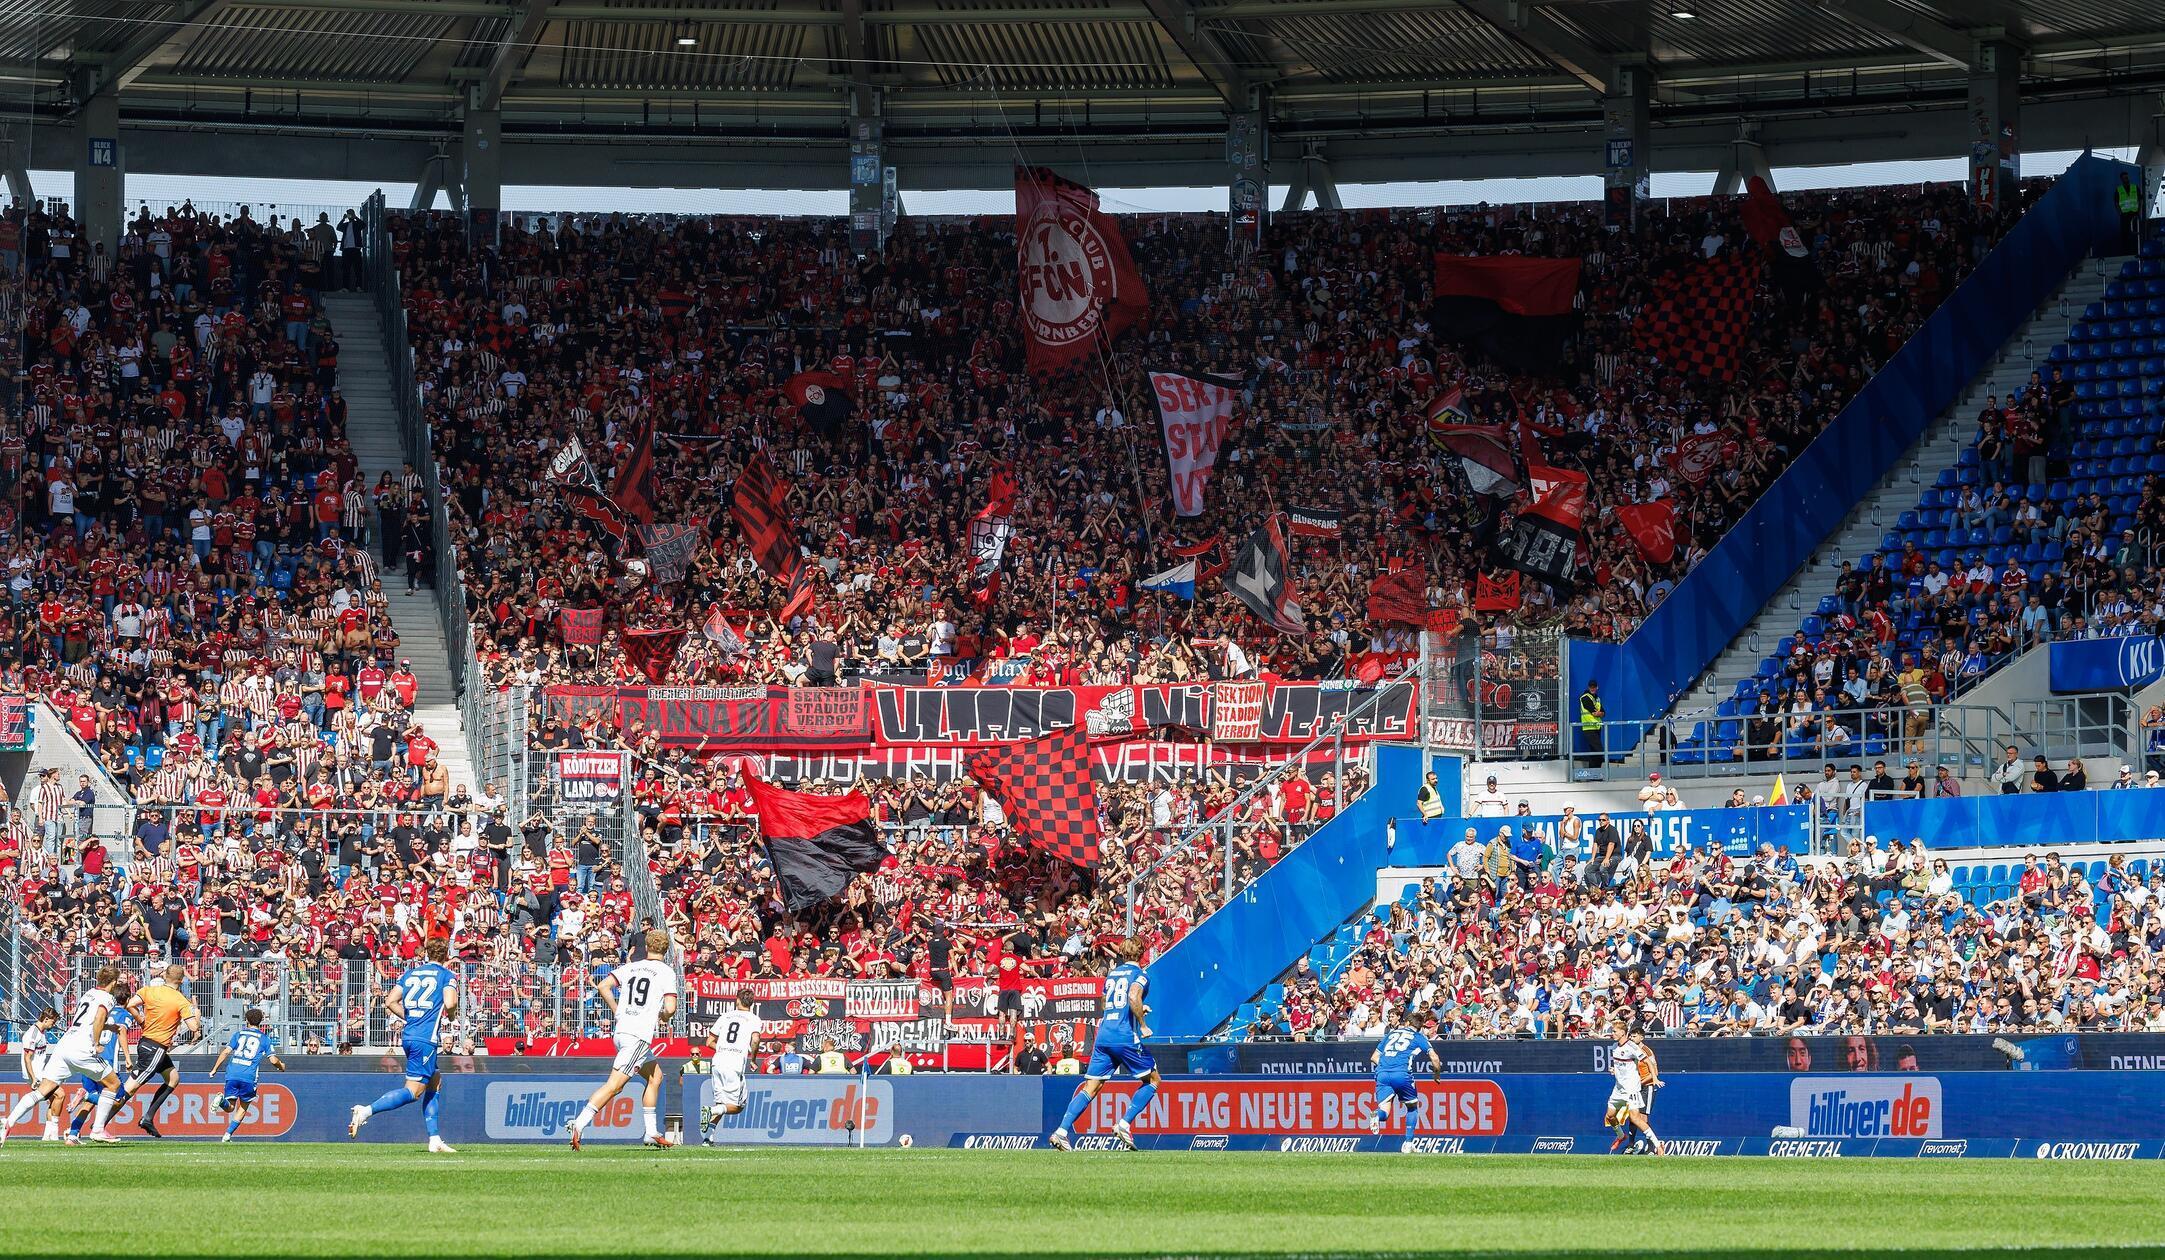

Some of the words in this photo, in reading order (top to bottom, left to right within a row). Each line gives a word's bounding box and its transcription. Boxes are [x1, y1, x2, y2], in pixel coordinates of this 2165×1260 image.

[94, 149, 111, 164] N4
[1028, 261, 1091, 304] FCN
[2129, 639, 2156, 680] KSC
[794, 690, 860, 703] SEKTION
[1217, 683, 1263, 704] SEKTION
[622, 701, 732, 734] BANDA
[794, 703, 859, 715] STADION
[1216, 706, 1262, 722] STADION
[797, 714, 856, 727] VERBOT
[1216, 723, 1259, 739] VERBOT
[565, 780, 594, 798] LAND
[1668, 815, 1692, 852] SC
[404, 976, 438, 1009] 22
[627, 976, 651, 1007] 19
[769, 985, 786, 997] DIE
[788, 980, 846, 997] BESESSENEN
[1105, 977, 1129, 1009] 28
[845, 985, 917, 1015] H3RZBLUT
[727, 1021, 741, 1044] 8
[234, 1035, 260, 1060] 19
[1384, 1032, 1415, 1052] 25
[1087, 1092, 1170, 1134] JEDEN
[1178, 1092, 1231, 1130] TAG
[1240, 1092, 1313, 1130] NEUE
[1322, 1092, 1493, 1131] BESPREISE
[1807, 1082, 1931, 1137] billiger.de
[975, 1134, 1040, 1150] CRONIMET
[1192, 1138, 1224, 1149] revomet
[1291, 1137, 1360, 1153] CRONIMET
[1536, 1141, 1569, 1151] revomet
[1768, 1140, 1842, 1158] CREMETAL
[1923, 1142, 1961, 1154] revomet
[2050, 1143, 2140, 1160] CRONIMET
